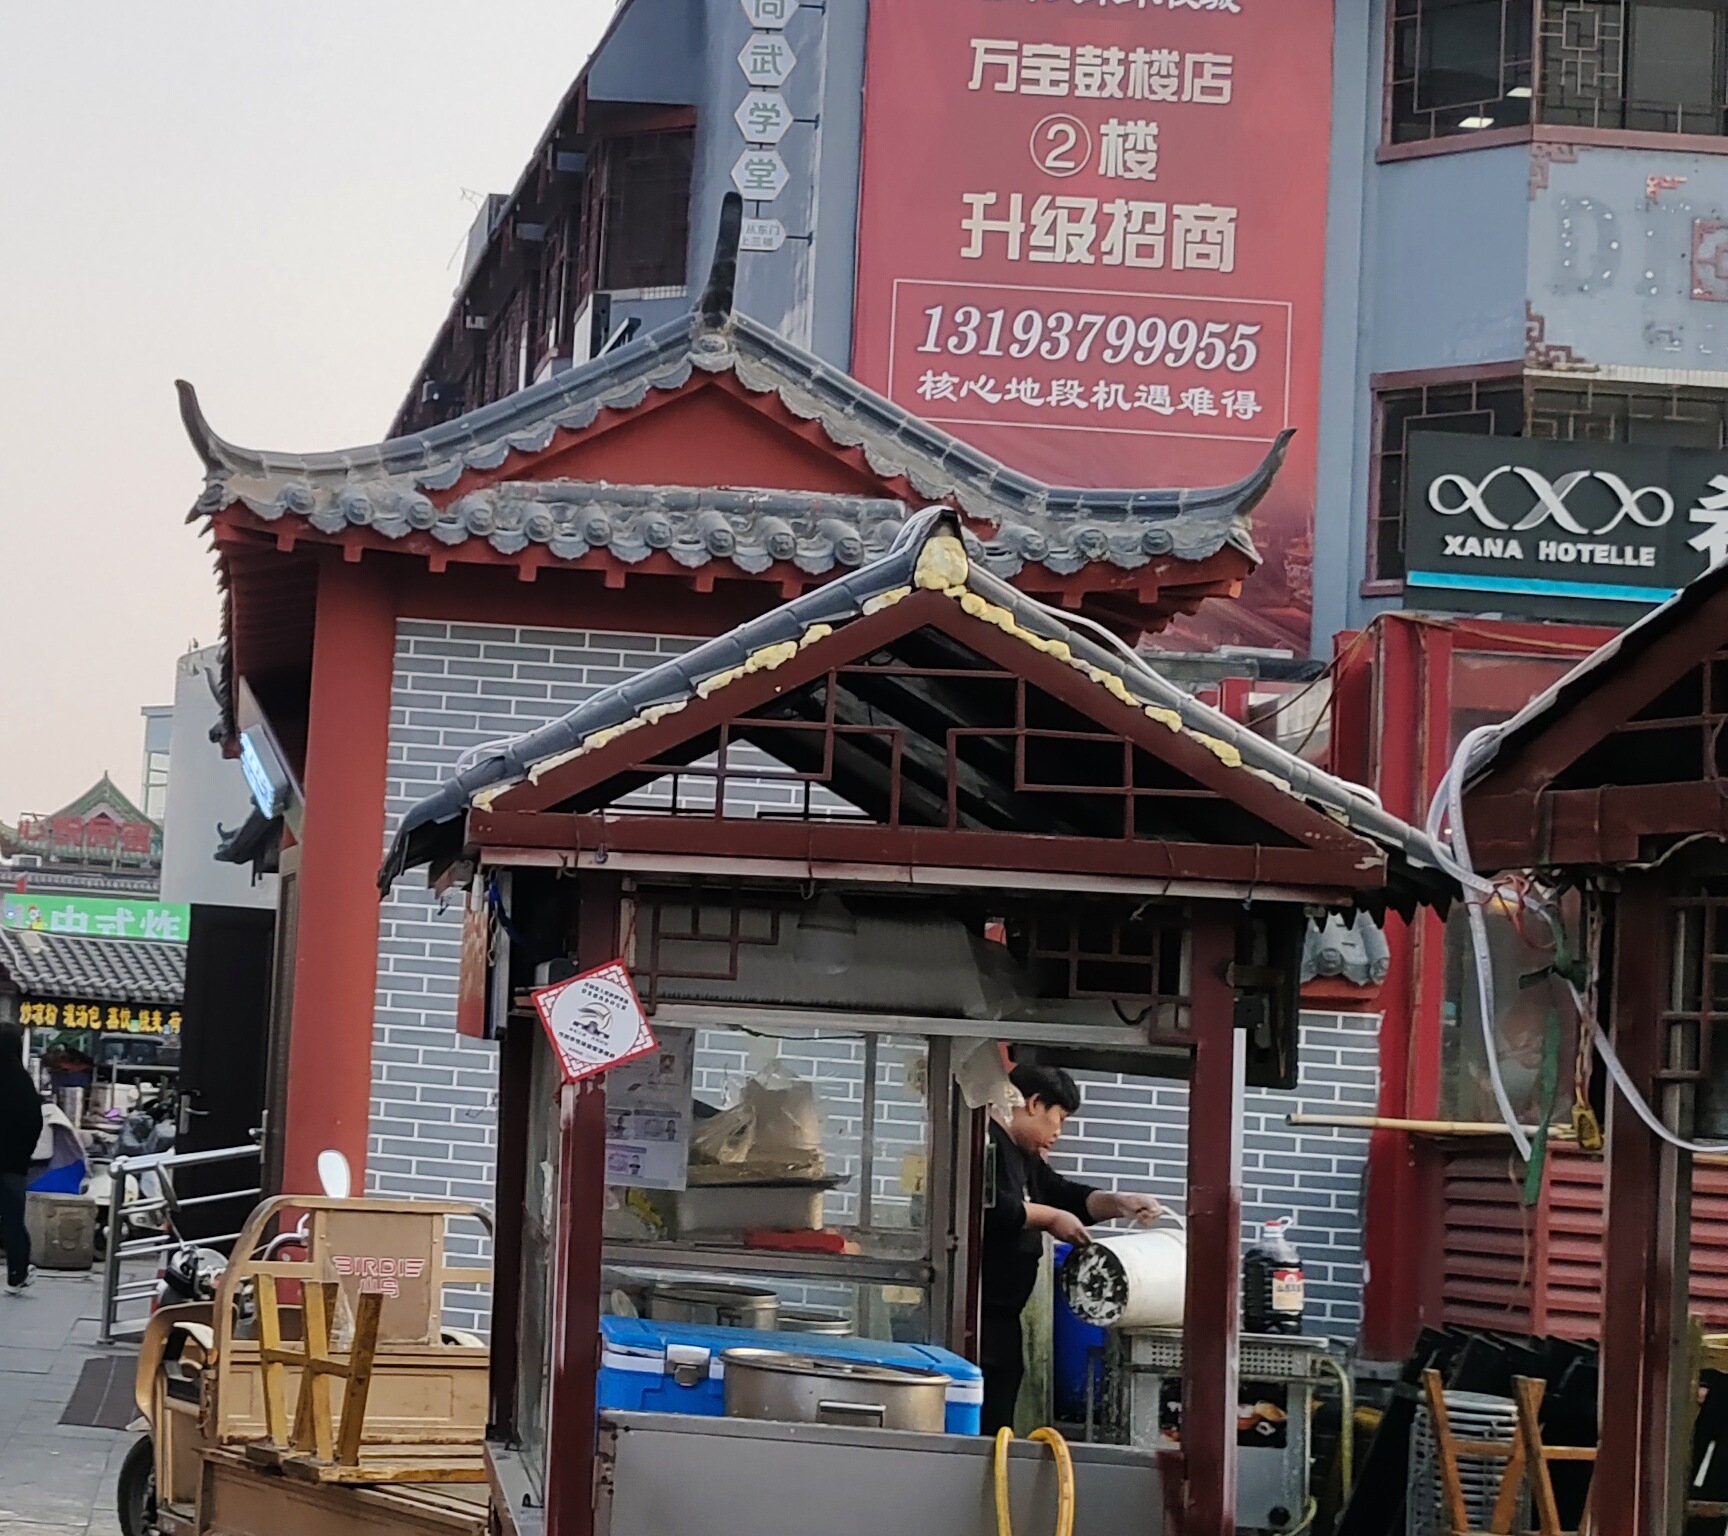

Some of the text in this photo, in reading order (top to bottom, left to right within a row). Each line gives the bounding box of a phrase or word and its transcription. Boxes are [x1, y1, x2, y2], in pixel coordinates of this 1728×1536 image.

[968, 38, 1233, 105] 万宝鼓楼店
[960, 191, 1238, 273] 升级招商
[917, 305, 1261, 372] 13193799955
[917, 370, 1262, 421] 核心地段机遇难得
[1443, 534, 1656, 567] XANA HOTELLE
[50, 904, 181, 941] 中式炸
[332, 1255, 426, 1277] BIRDIE
